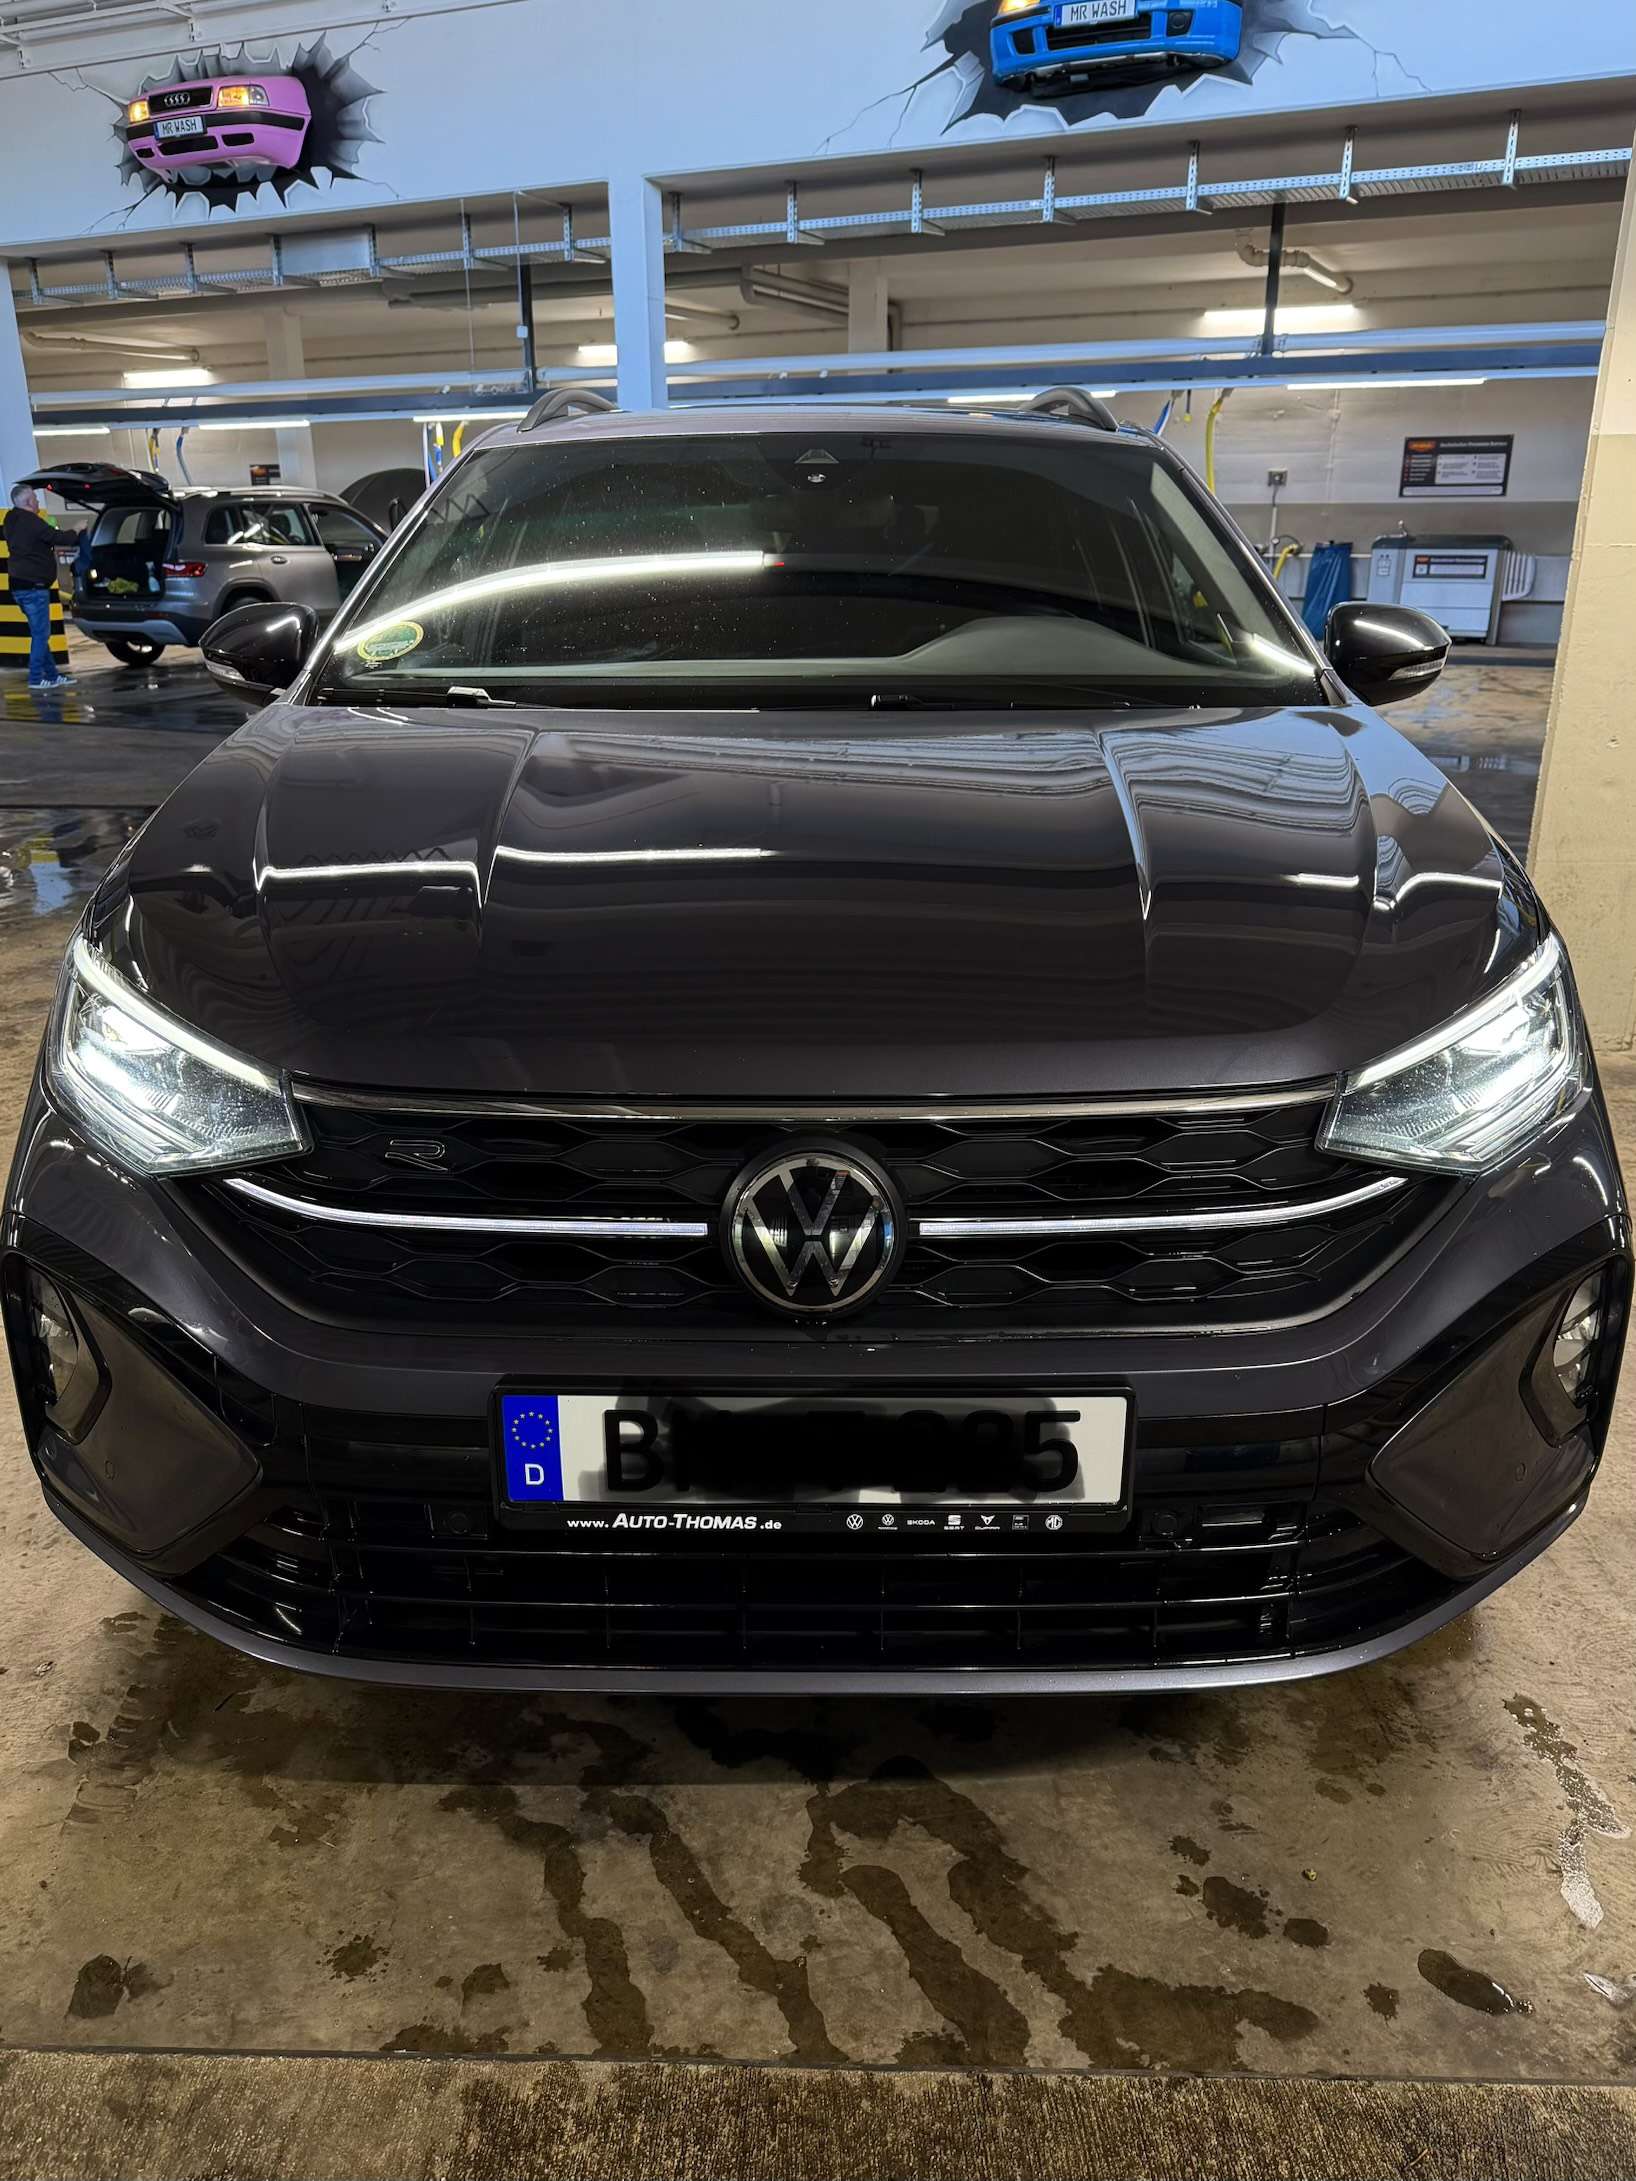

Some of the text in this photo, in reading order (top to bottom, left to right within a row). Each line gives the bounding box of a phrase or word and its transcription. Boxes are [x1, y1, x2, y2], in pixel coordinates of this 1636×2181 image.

[1070, 0, 1127, 21] MR WASH
[162, 118, 197, 135] MR WASH
[524, 1463, 545, 1486] D
